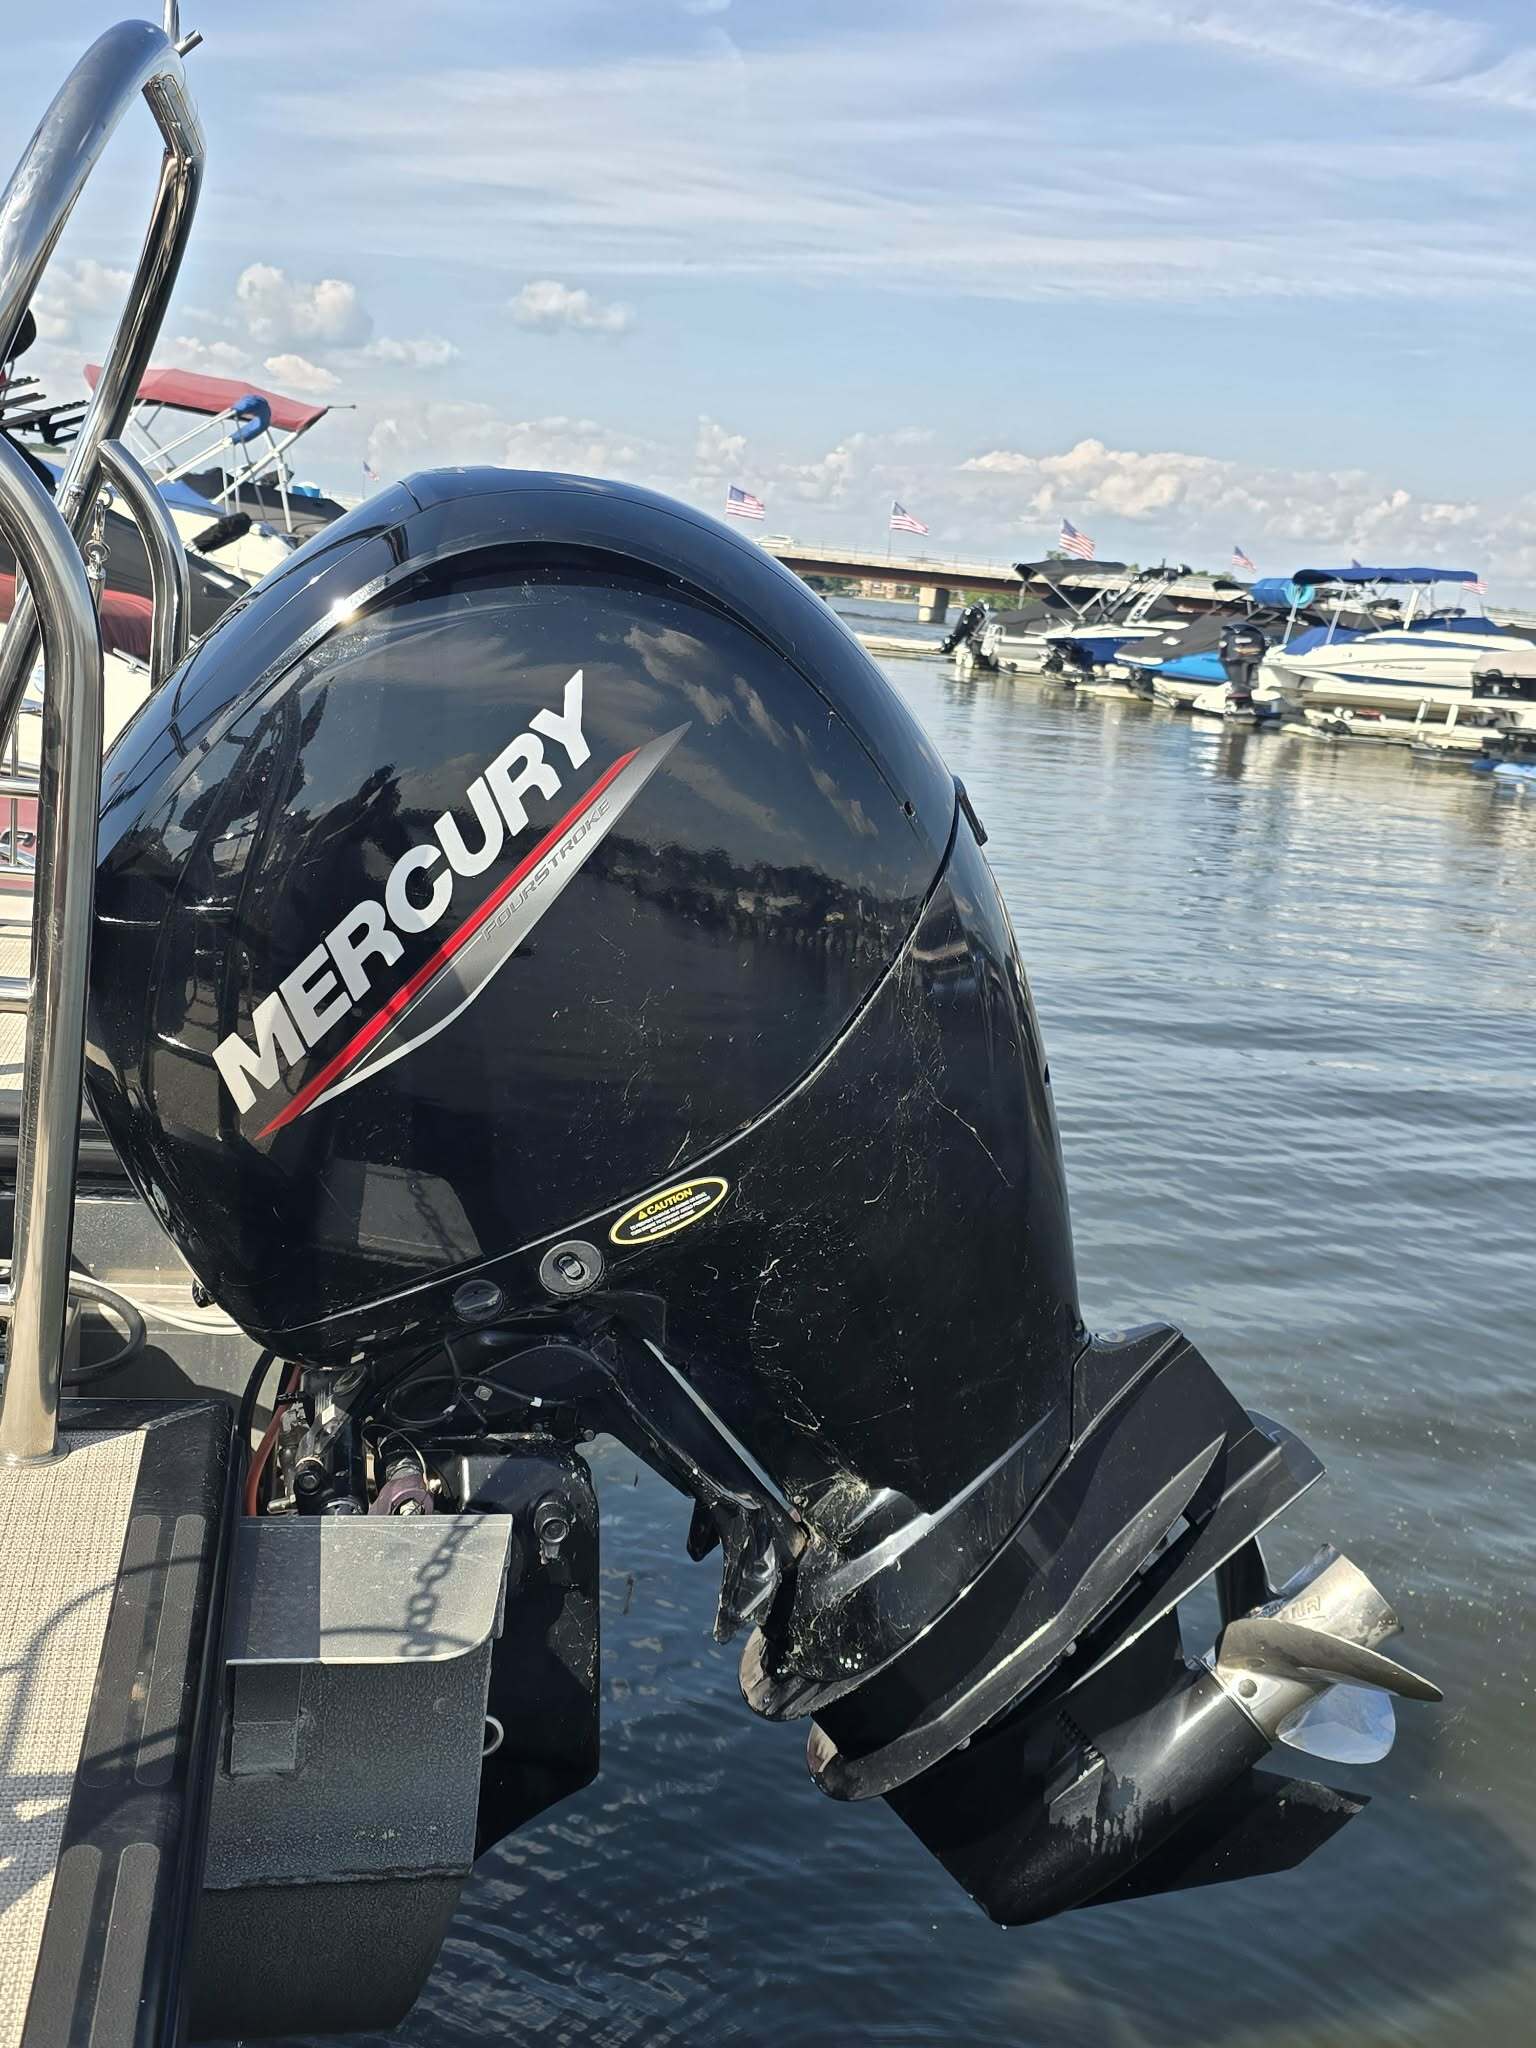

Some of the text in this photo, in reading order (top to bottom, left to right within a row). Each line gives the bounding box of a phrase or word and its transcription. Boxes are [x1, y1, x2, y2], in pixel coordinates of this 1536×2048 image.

[212, 669, 591, 1114] MERCURY
[481, 796, 610, 943] FOURSTROKE
[646, 1188, 693, 1214] CAUTION
